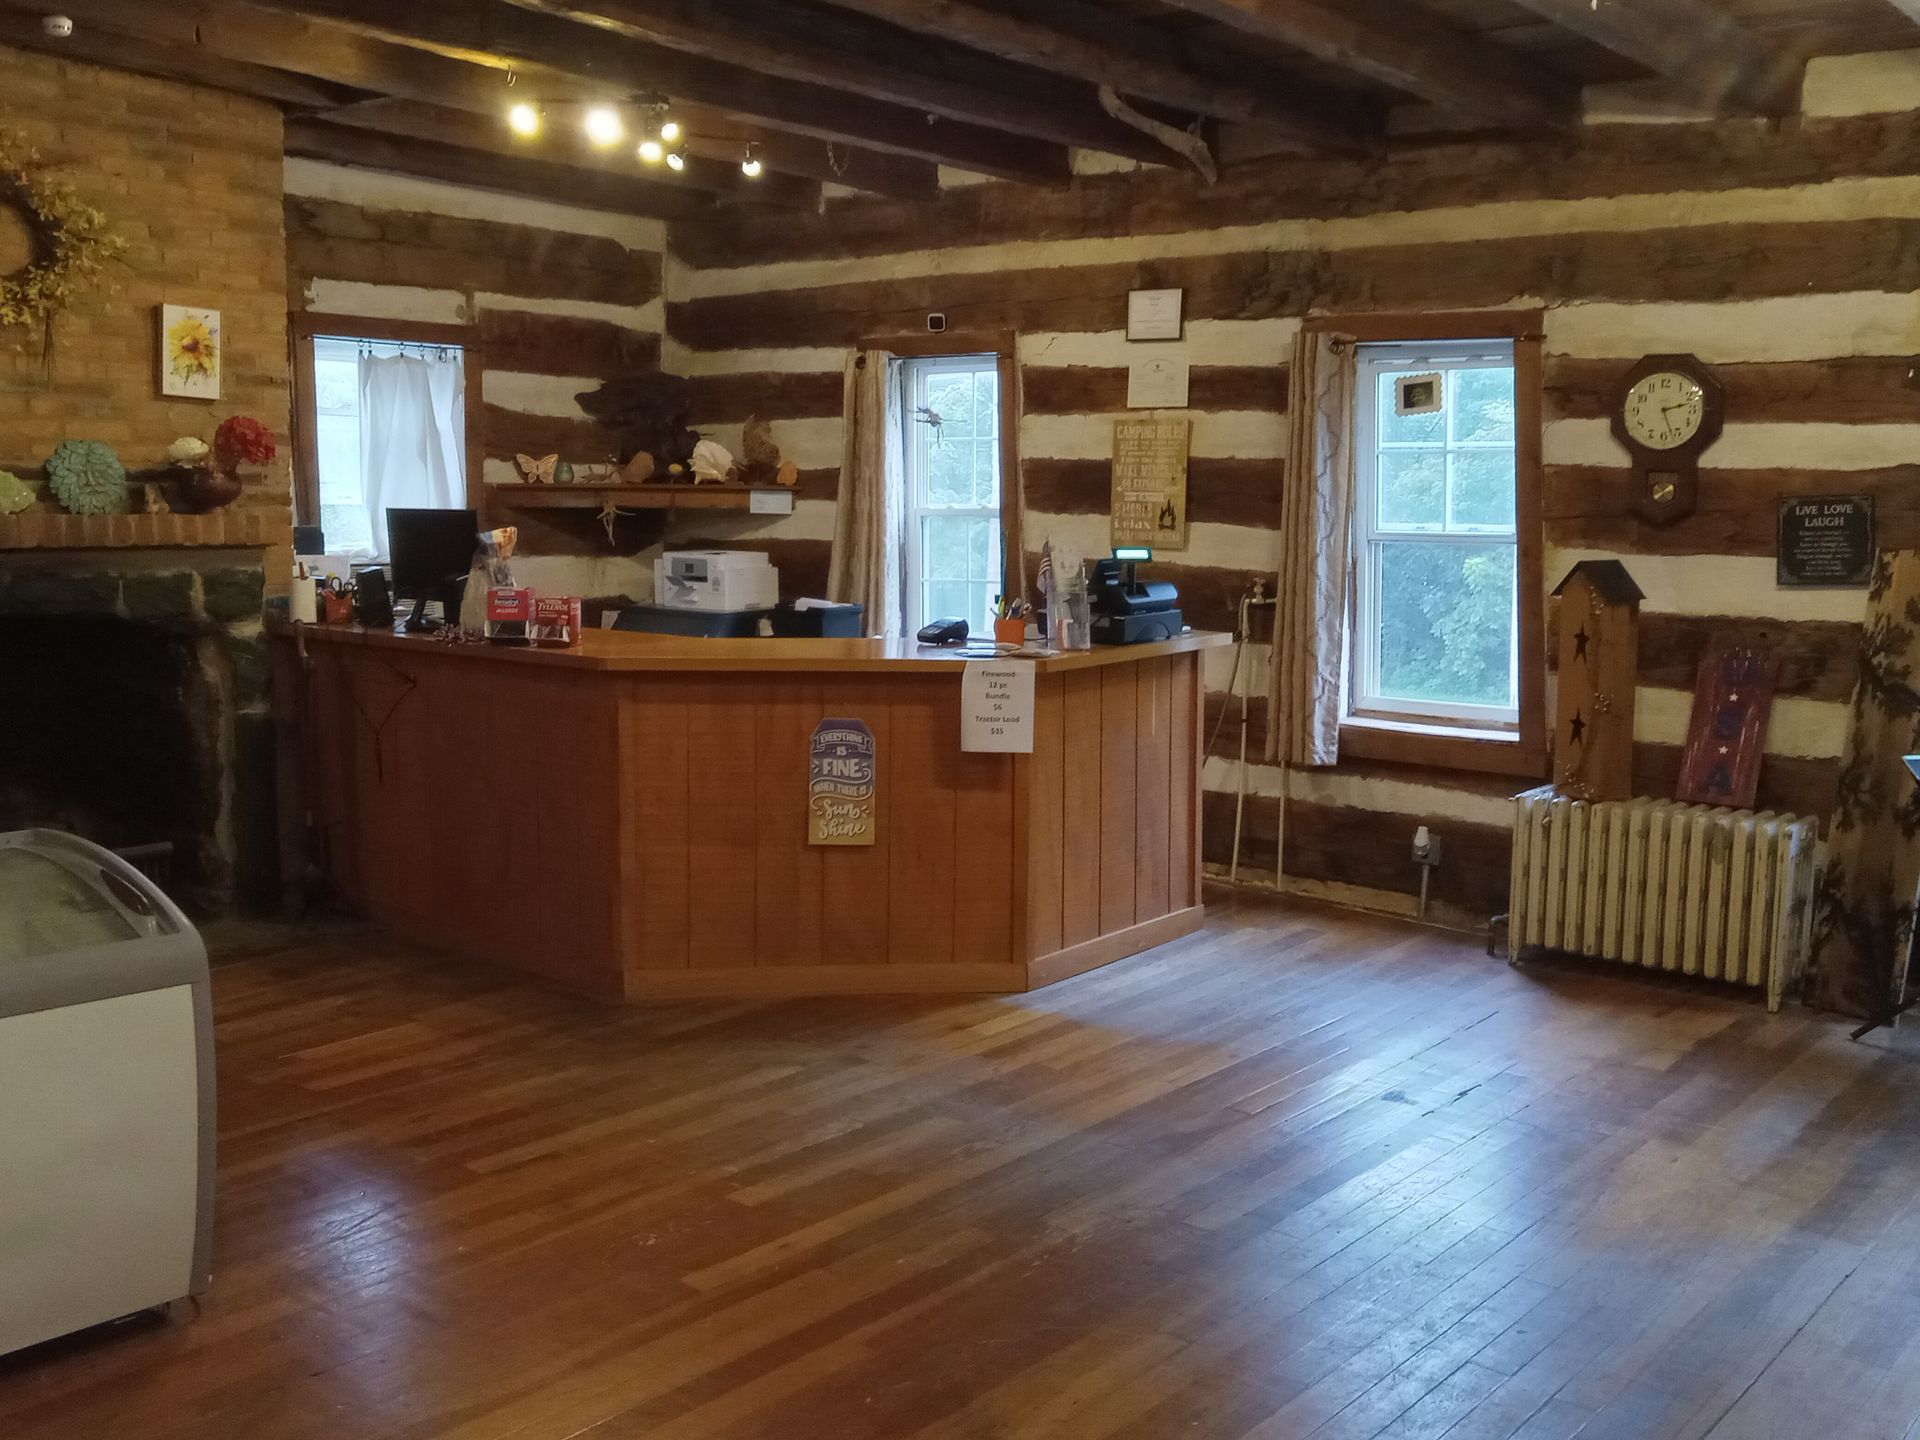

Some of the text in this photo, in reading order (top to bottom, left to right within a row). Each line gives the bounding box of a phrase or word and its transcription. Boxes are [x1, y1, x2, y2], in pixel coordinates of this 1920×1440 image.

[1648, 383, 1655, 393] 11
[1661, 378, 1671, 389] 12
[1638, 394, 1647, 403] 10
[1632, 406, 1640, 416] 9
[1117, 425, 1183, 439] CAMPING RULES
[1660, 431, 1667, 440] 6
[1674, 427, 1681, 437] 5
[1796, 504, 1854, 515] LIVE LOVE
[1805, 517, 1844, 527] LAUGH
[537, 602, 568, 611] TYLENOL
[981, 670, 1016, 678] Firewood
[985, 692, 1010, 700] Bundle
[993, 703, 1002, 711] $6
[975, 715, 1020, 723] Tractor Load
[820, 732, 863, 743] EVERYTHING
[836, 746, 847, 756] IS
[822, 758, 863, 777] FINE
[813, 781, 867, 796] WHEN THERE IS
[823, 799, 861, 820] Sun
[819, 818, 867, 840] Shine
